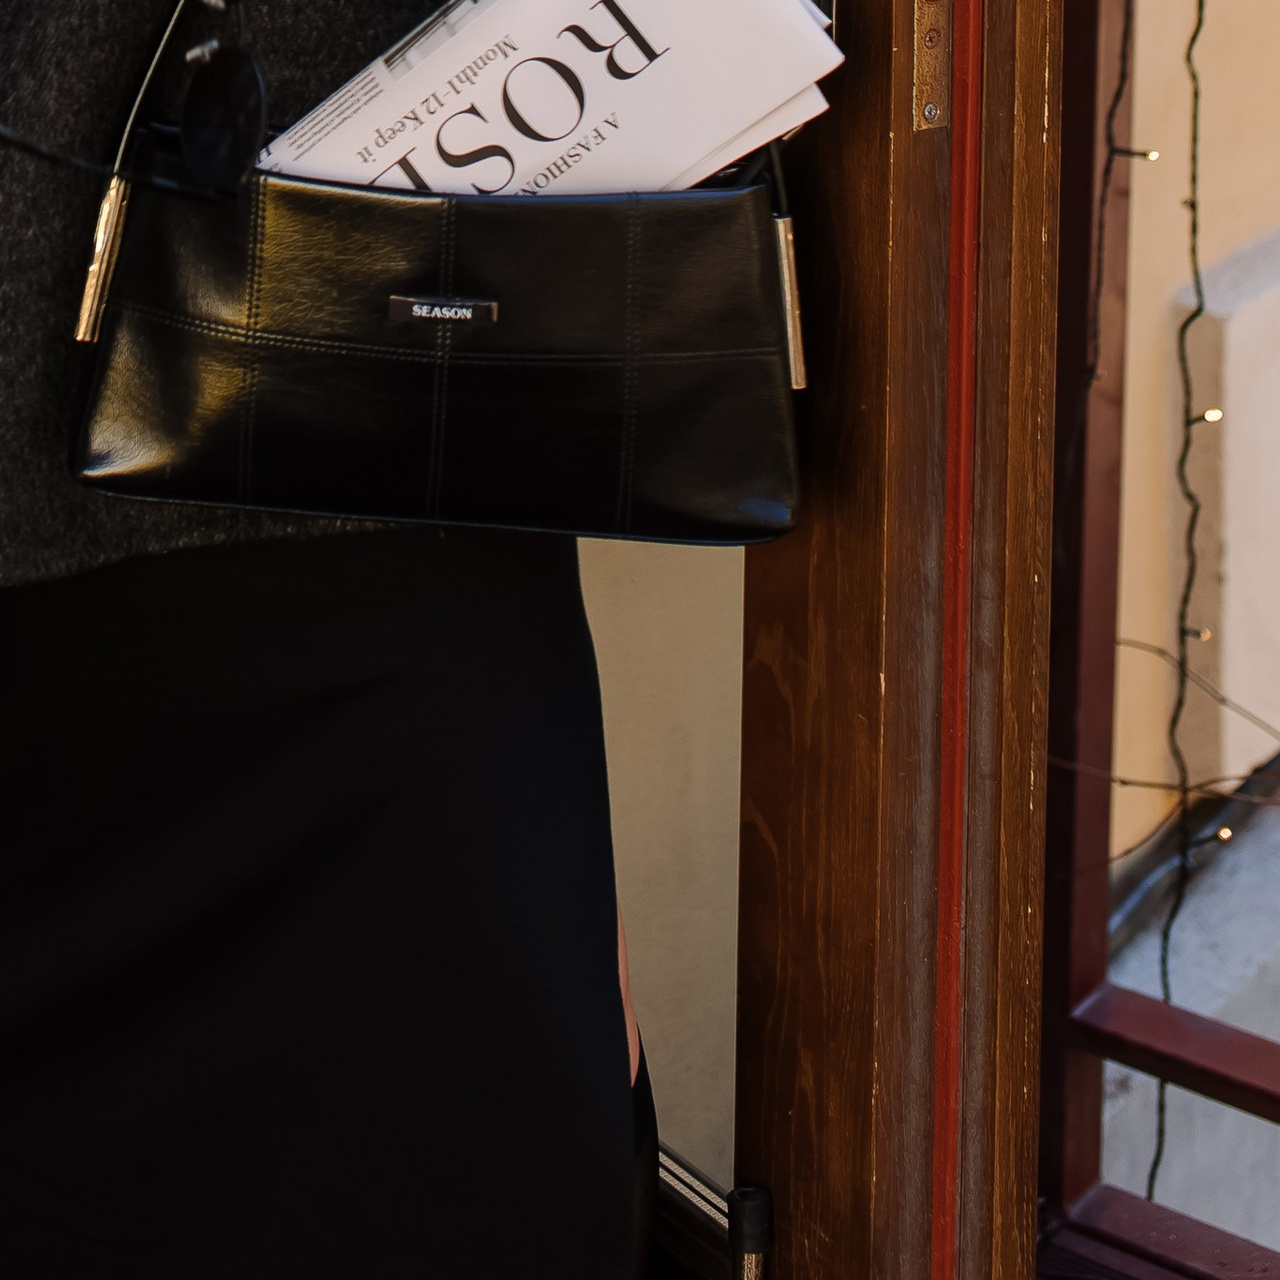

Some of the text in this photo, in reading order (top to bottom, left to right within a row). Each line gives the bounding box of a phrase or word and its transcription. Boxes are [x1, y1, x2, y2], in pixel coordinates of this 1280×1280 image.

[373, 107, 425, 149] Keep
[355, 145, 378, 164] it
[514, 112, 620, 196] A FASHION
[412, 304, 473, 319] SEASON
